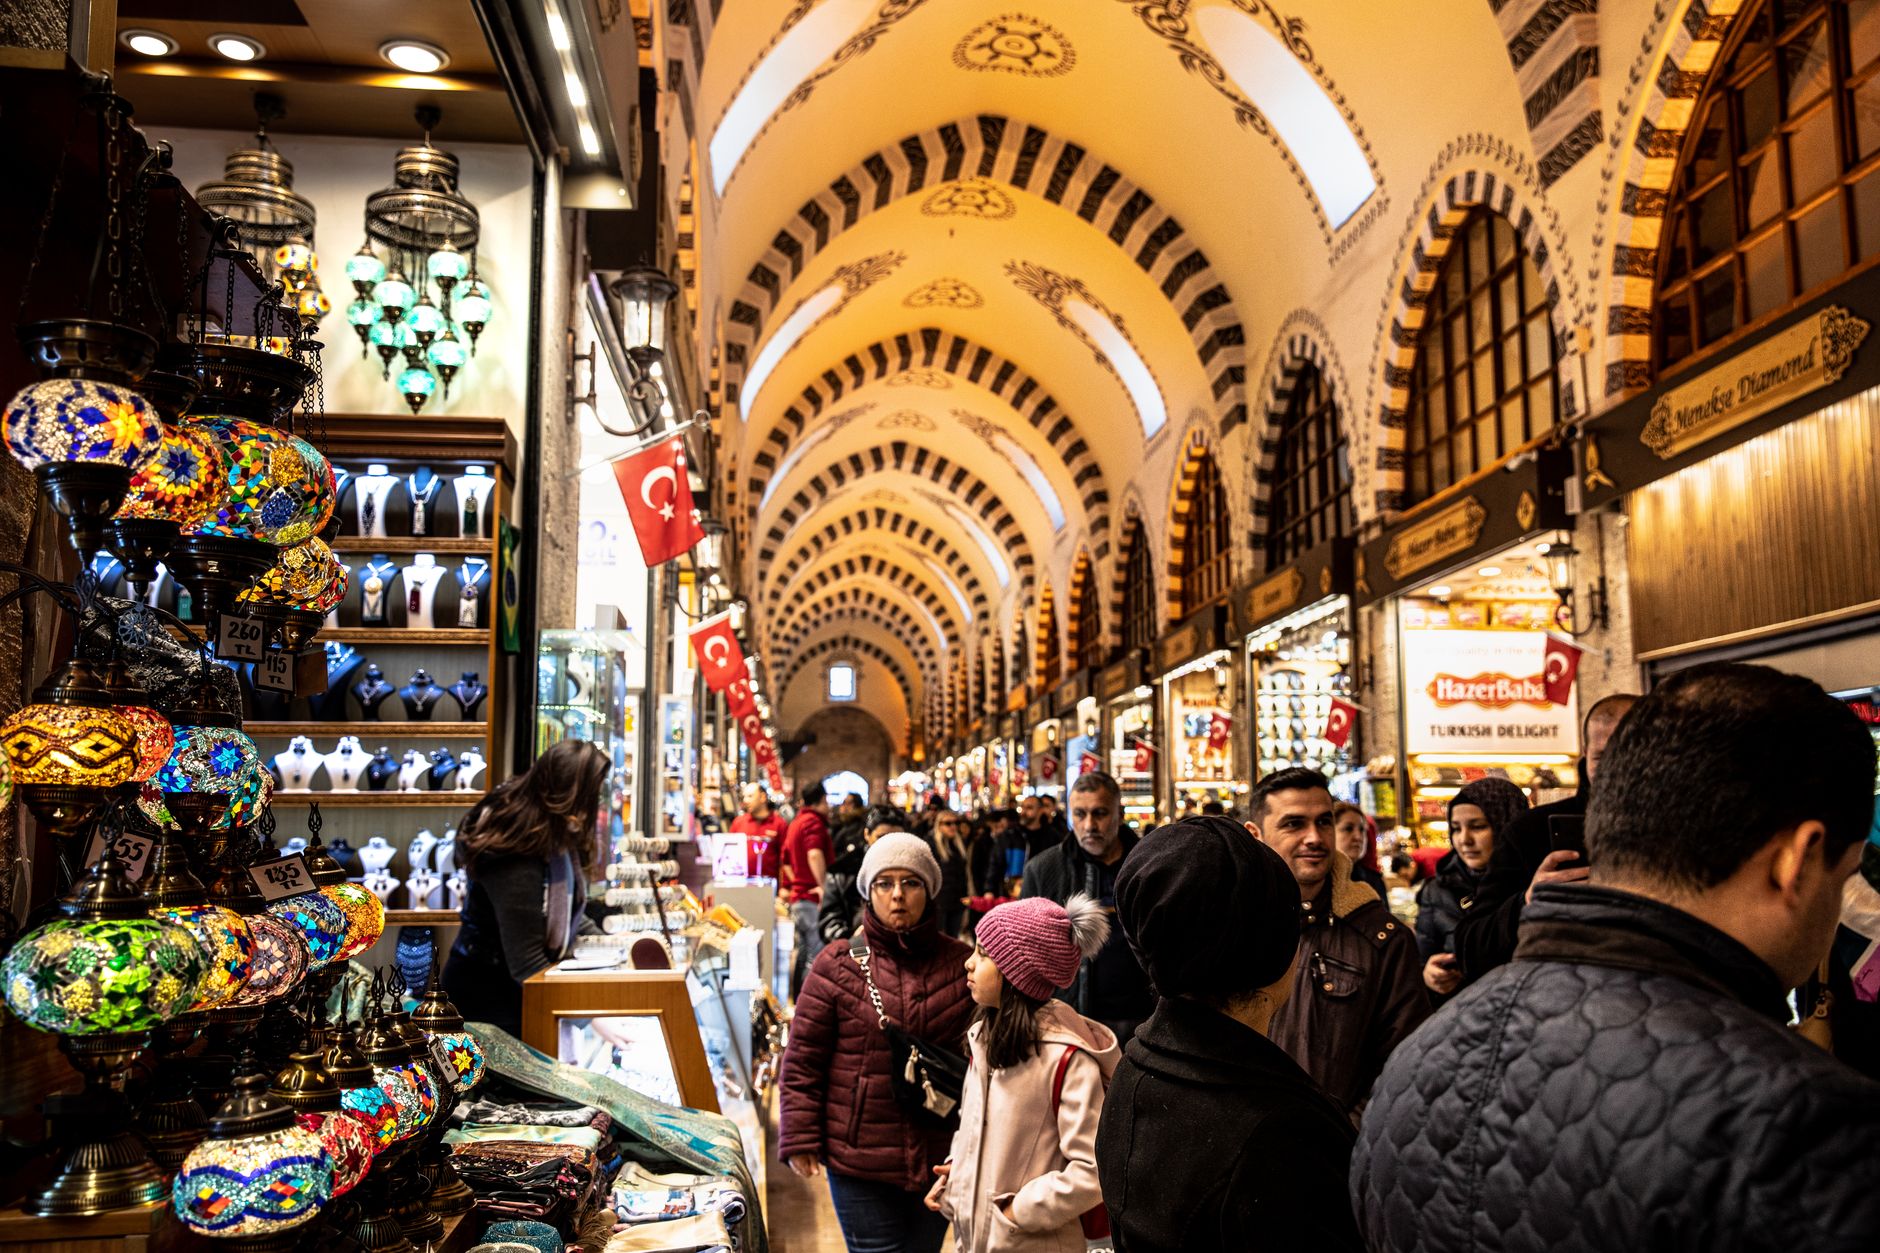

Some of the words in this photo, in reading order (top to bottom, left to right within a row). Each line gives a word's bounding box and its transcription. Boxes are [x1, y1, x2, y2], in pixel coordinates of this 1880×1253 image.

[1737, 335, 1818, 403] Diamond
[235, 644, 256, 655] TL
[266, 655, 287, 674] 115
[269, 675, 285, 685] TL
[1430, 724, 1492, 738] TURKISH
[1497, 724, 1559, 738] DELIGHT
[280, 879, 304, 890] TL
